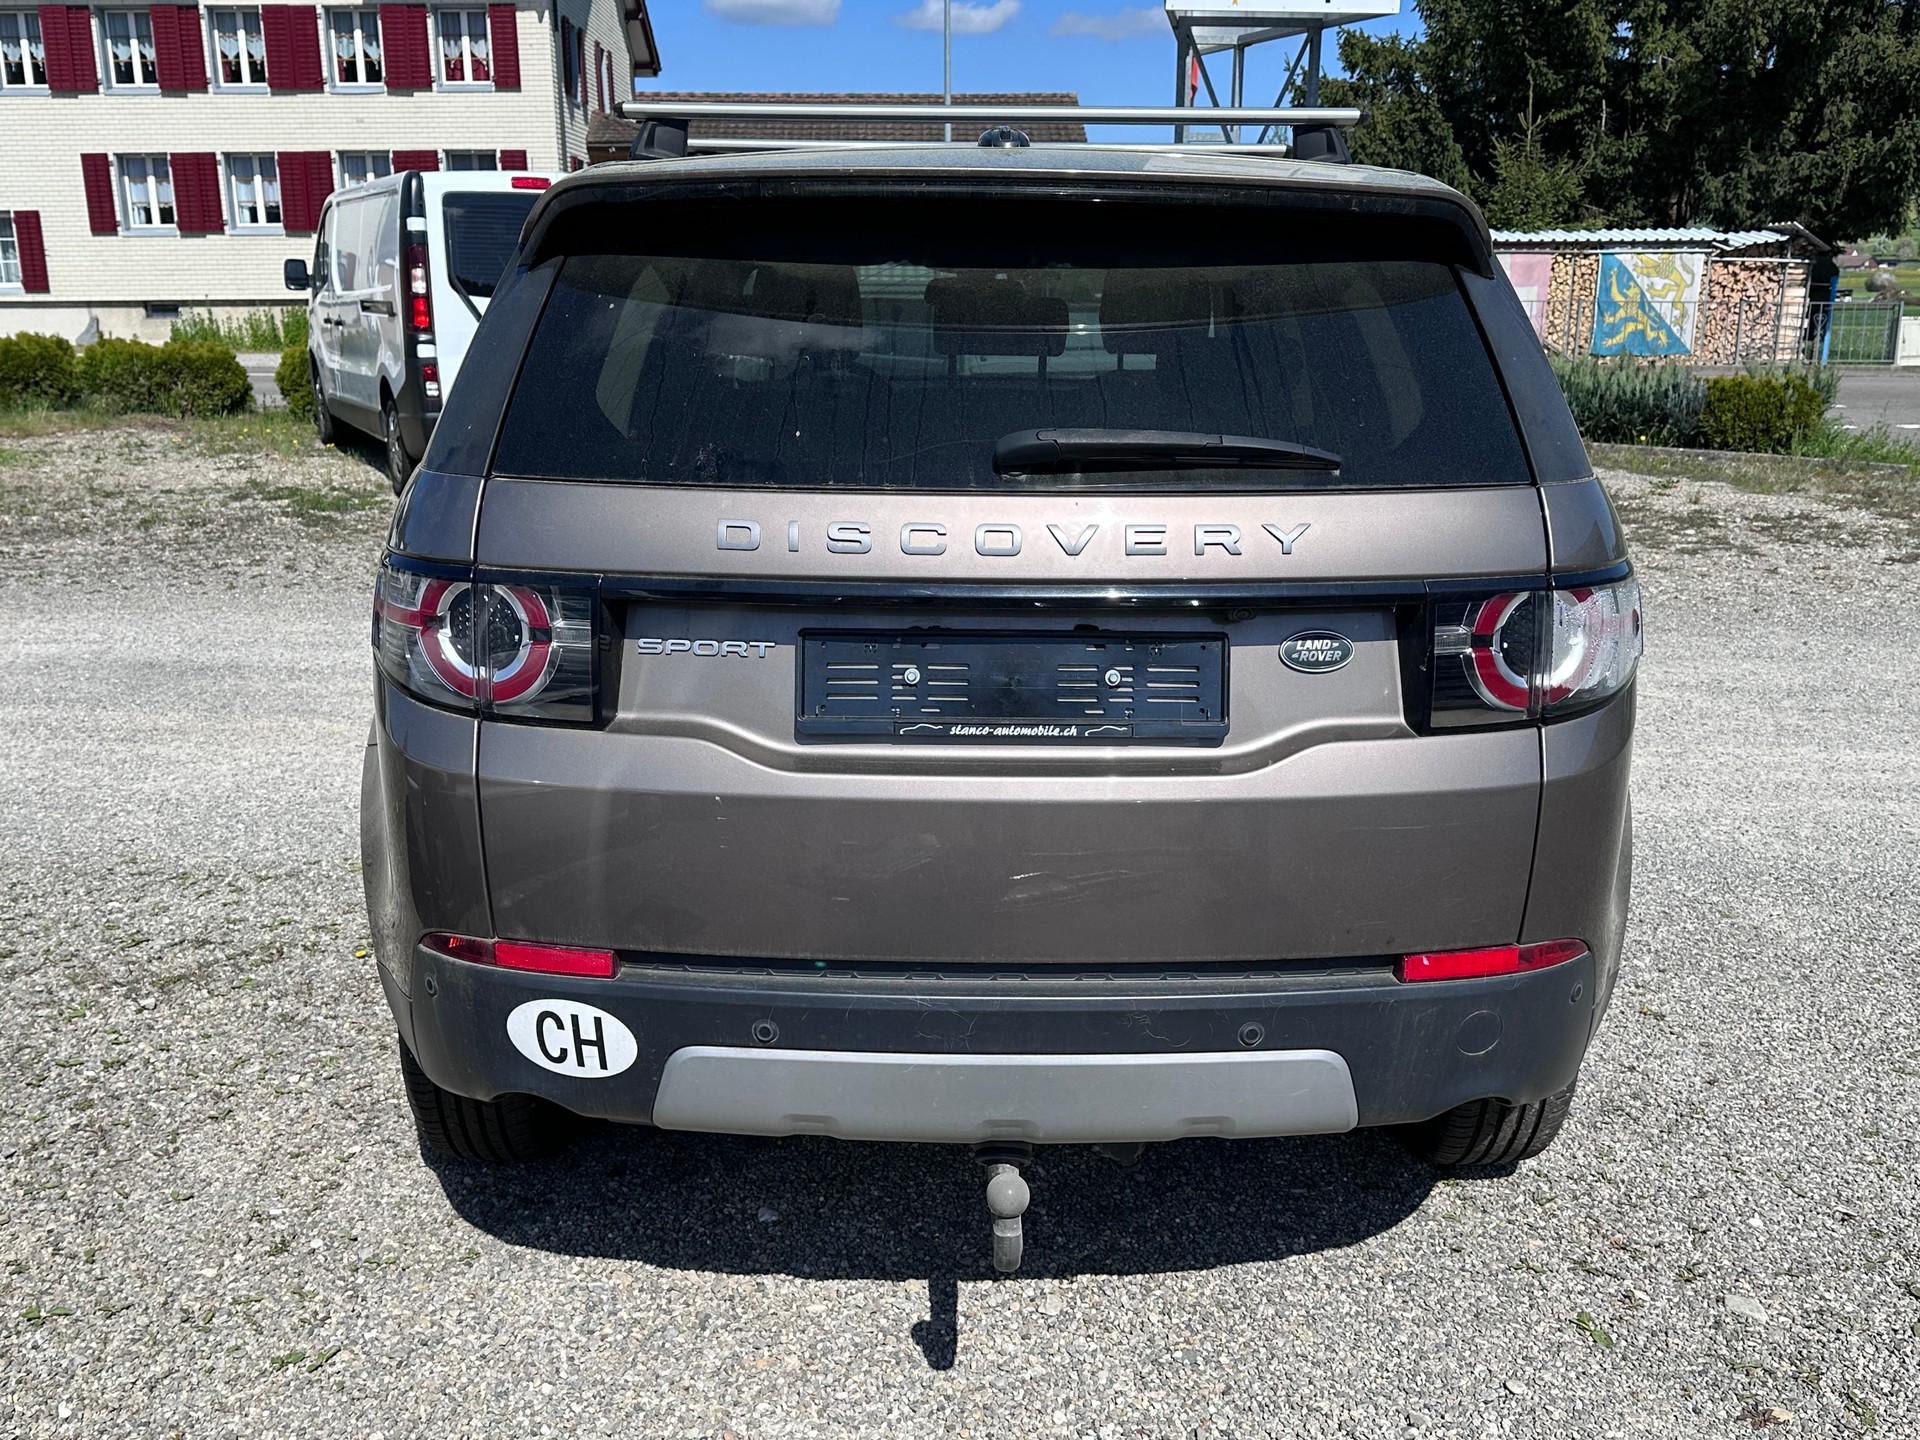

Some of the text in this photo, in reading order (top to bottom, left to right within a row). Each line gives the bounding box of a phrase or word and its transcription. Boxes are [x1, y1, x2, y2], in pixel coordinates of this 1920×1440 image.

[717, 519, 1311, 556] DISCOVERY
[638, 638, 775, 658] SPORT
[1296, 640, 1331, 650] LAND
[1299, 651, 1342, 661] ROVER
[949, 724, 1077, 737] stanco-automobile.ch
[536, 1010, 608, 1070] CH
